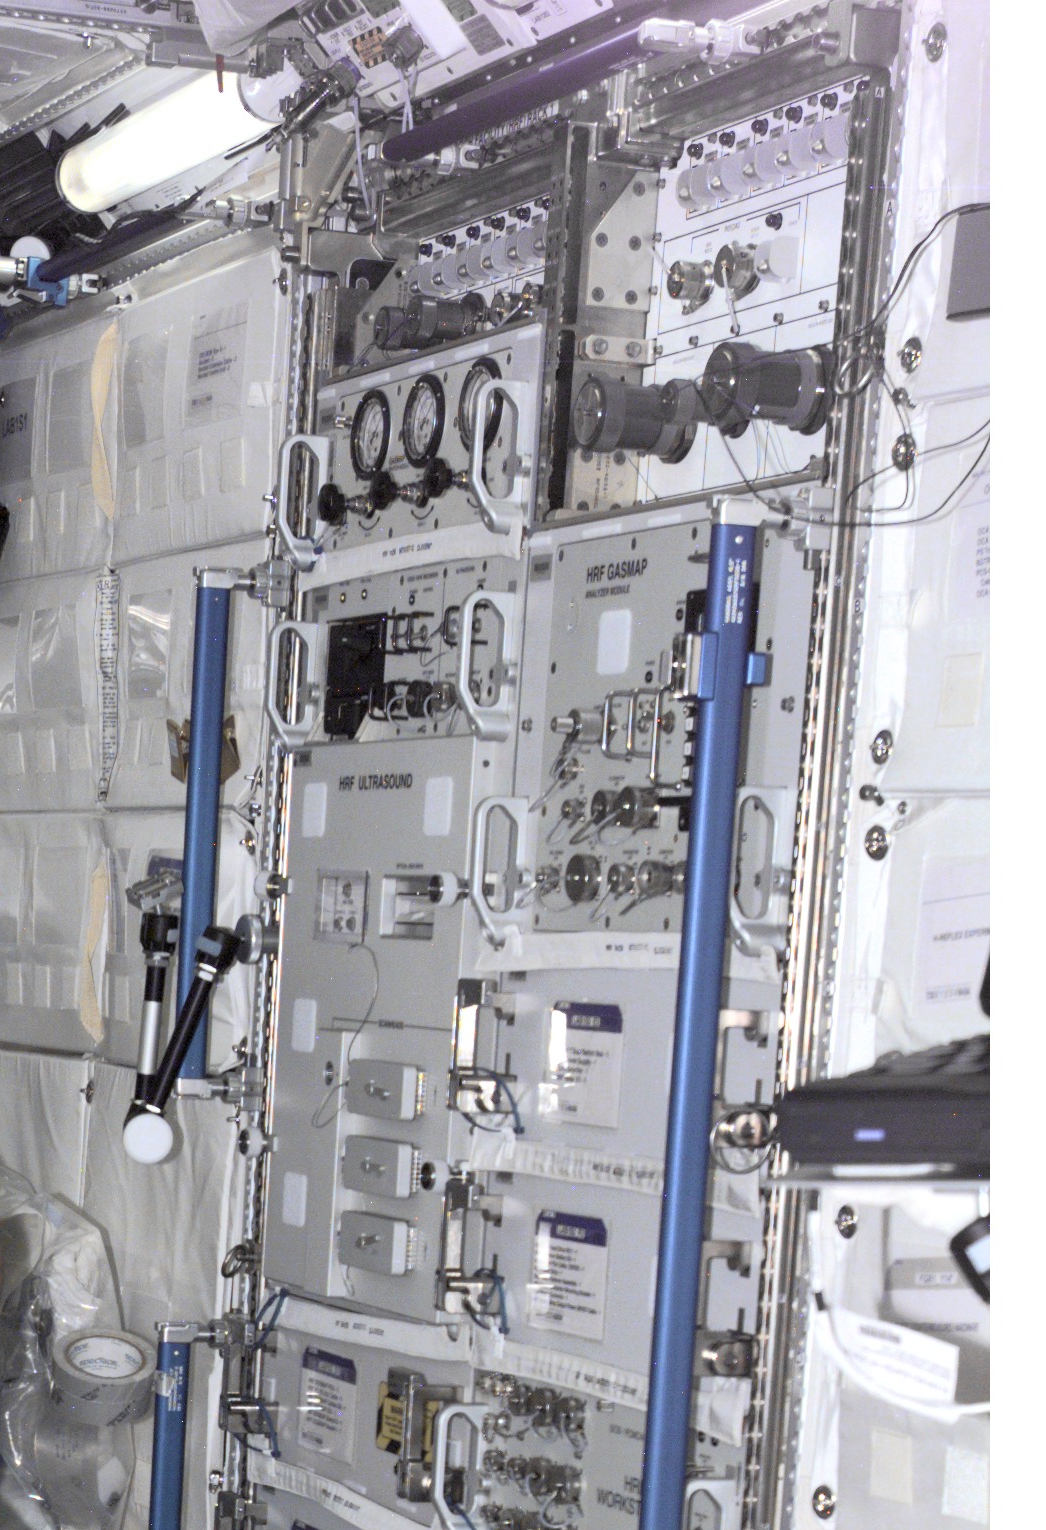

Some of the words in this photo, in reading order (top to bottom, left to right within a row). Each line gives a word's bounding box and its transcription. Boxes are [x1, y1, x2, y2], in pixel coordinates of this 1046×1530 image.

[586, 565, 605, 584] HRF
[607, 558, 648, 582] GASMAP
[339, 775, 355, 791] HRF
[358, 772, 414, 791] ULTRASOUND
[624, 1475, 641, 1494] HR
[597, 1488, 642, 1516] WORKST
